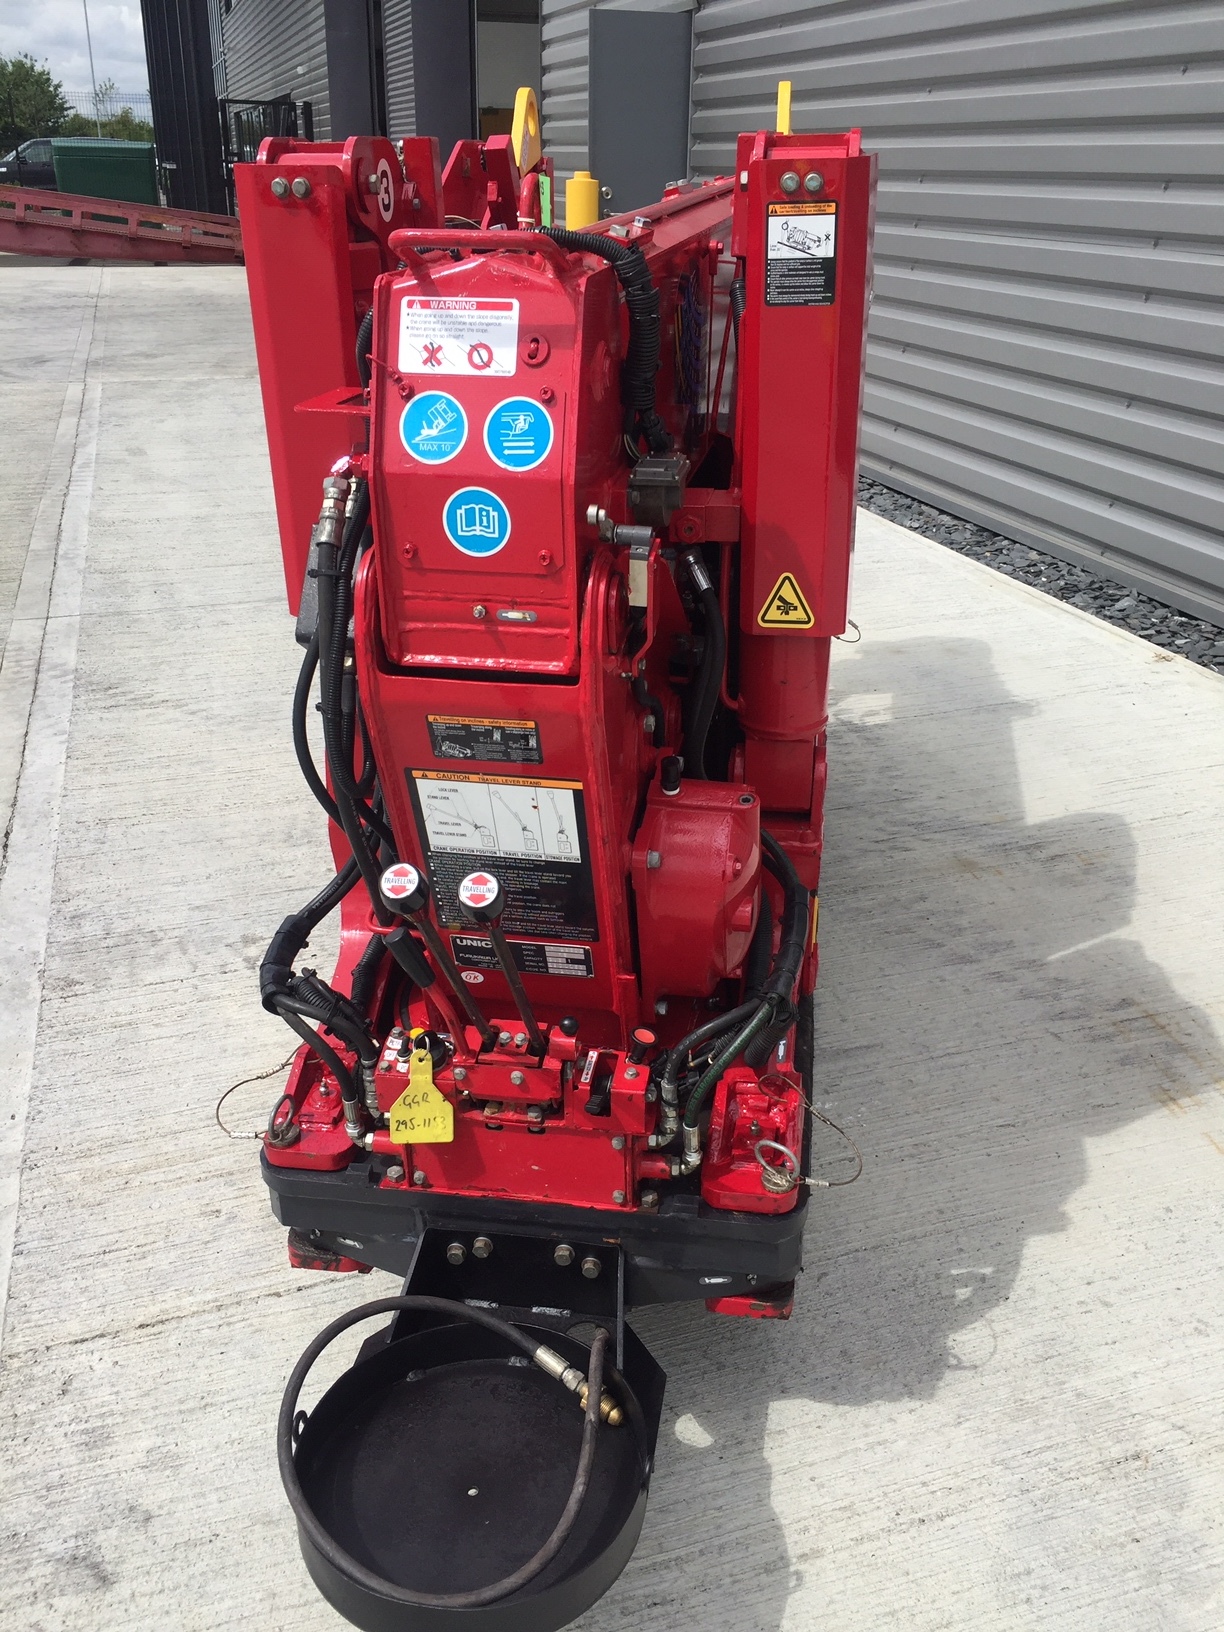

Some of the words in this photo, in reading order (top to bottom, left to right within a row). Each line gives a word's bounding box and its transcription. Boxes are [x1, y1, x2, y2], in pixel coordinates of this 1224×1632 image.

[381, 170, 391, 212] 3
[430, 300, 477, 310] WARNING
[436, 773, 470, 781] CAUTION
[475, 848, 498, 856] POSITION
[384, 877, 416, 885] TRAVELLING
[462, 885, 495, 894] TRAVELLING
[456, 938, 492, 948] UNIC
[403, 1092, 430, 1109] GGR
